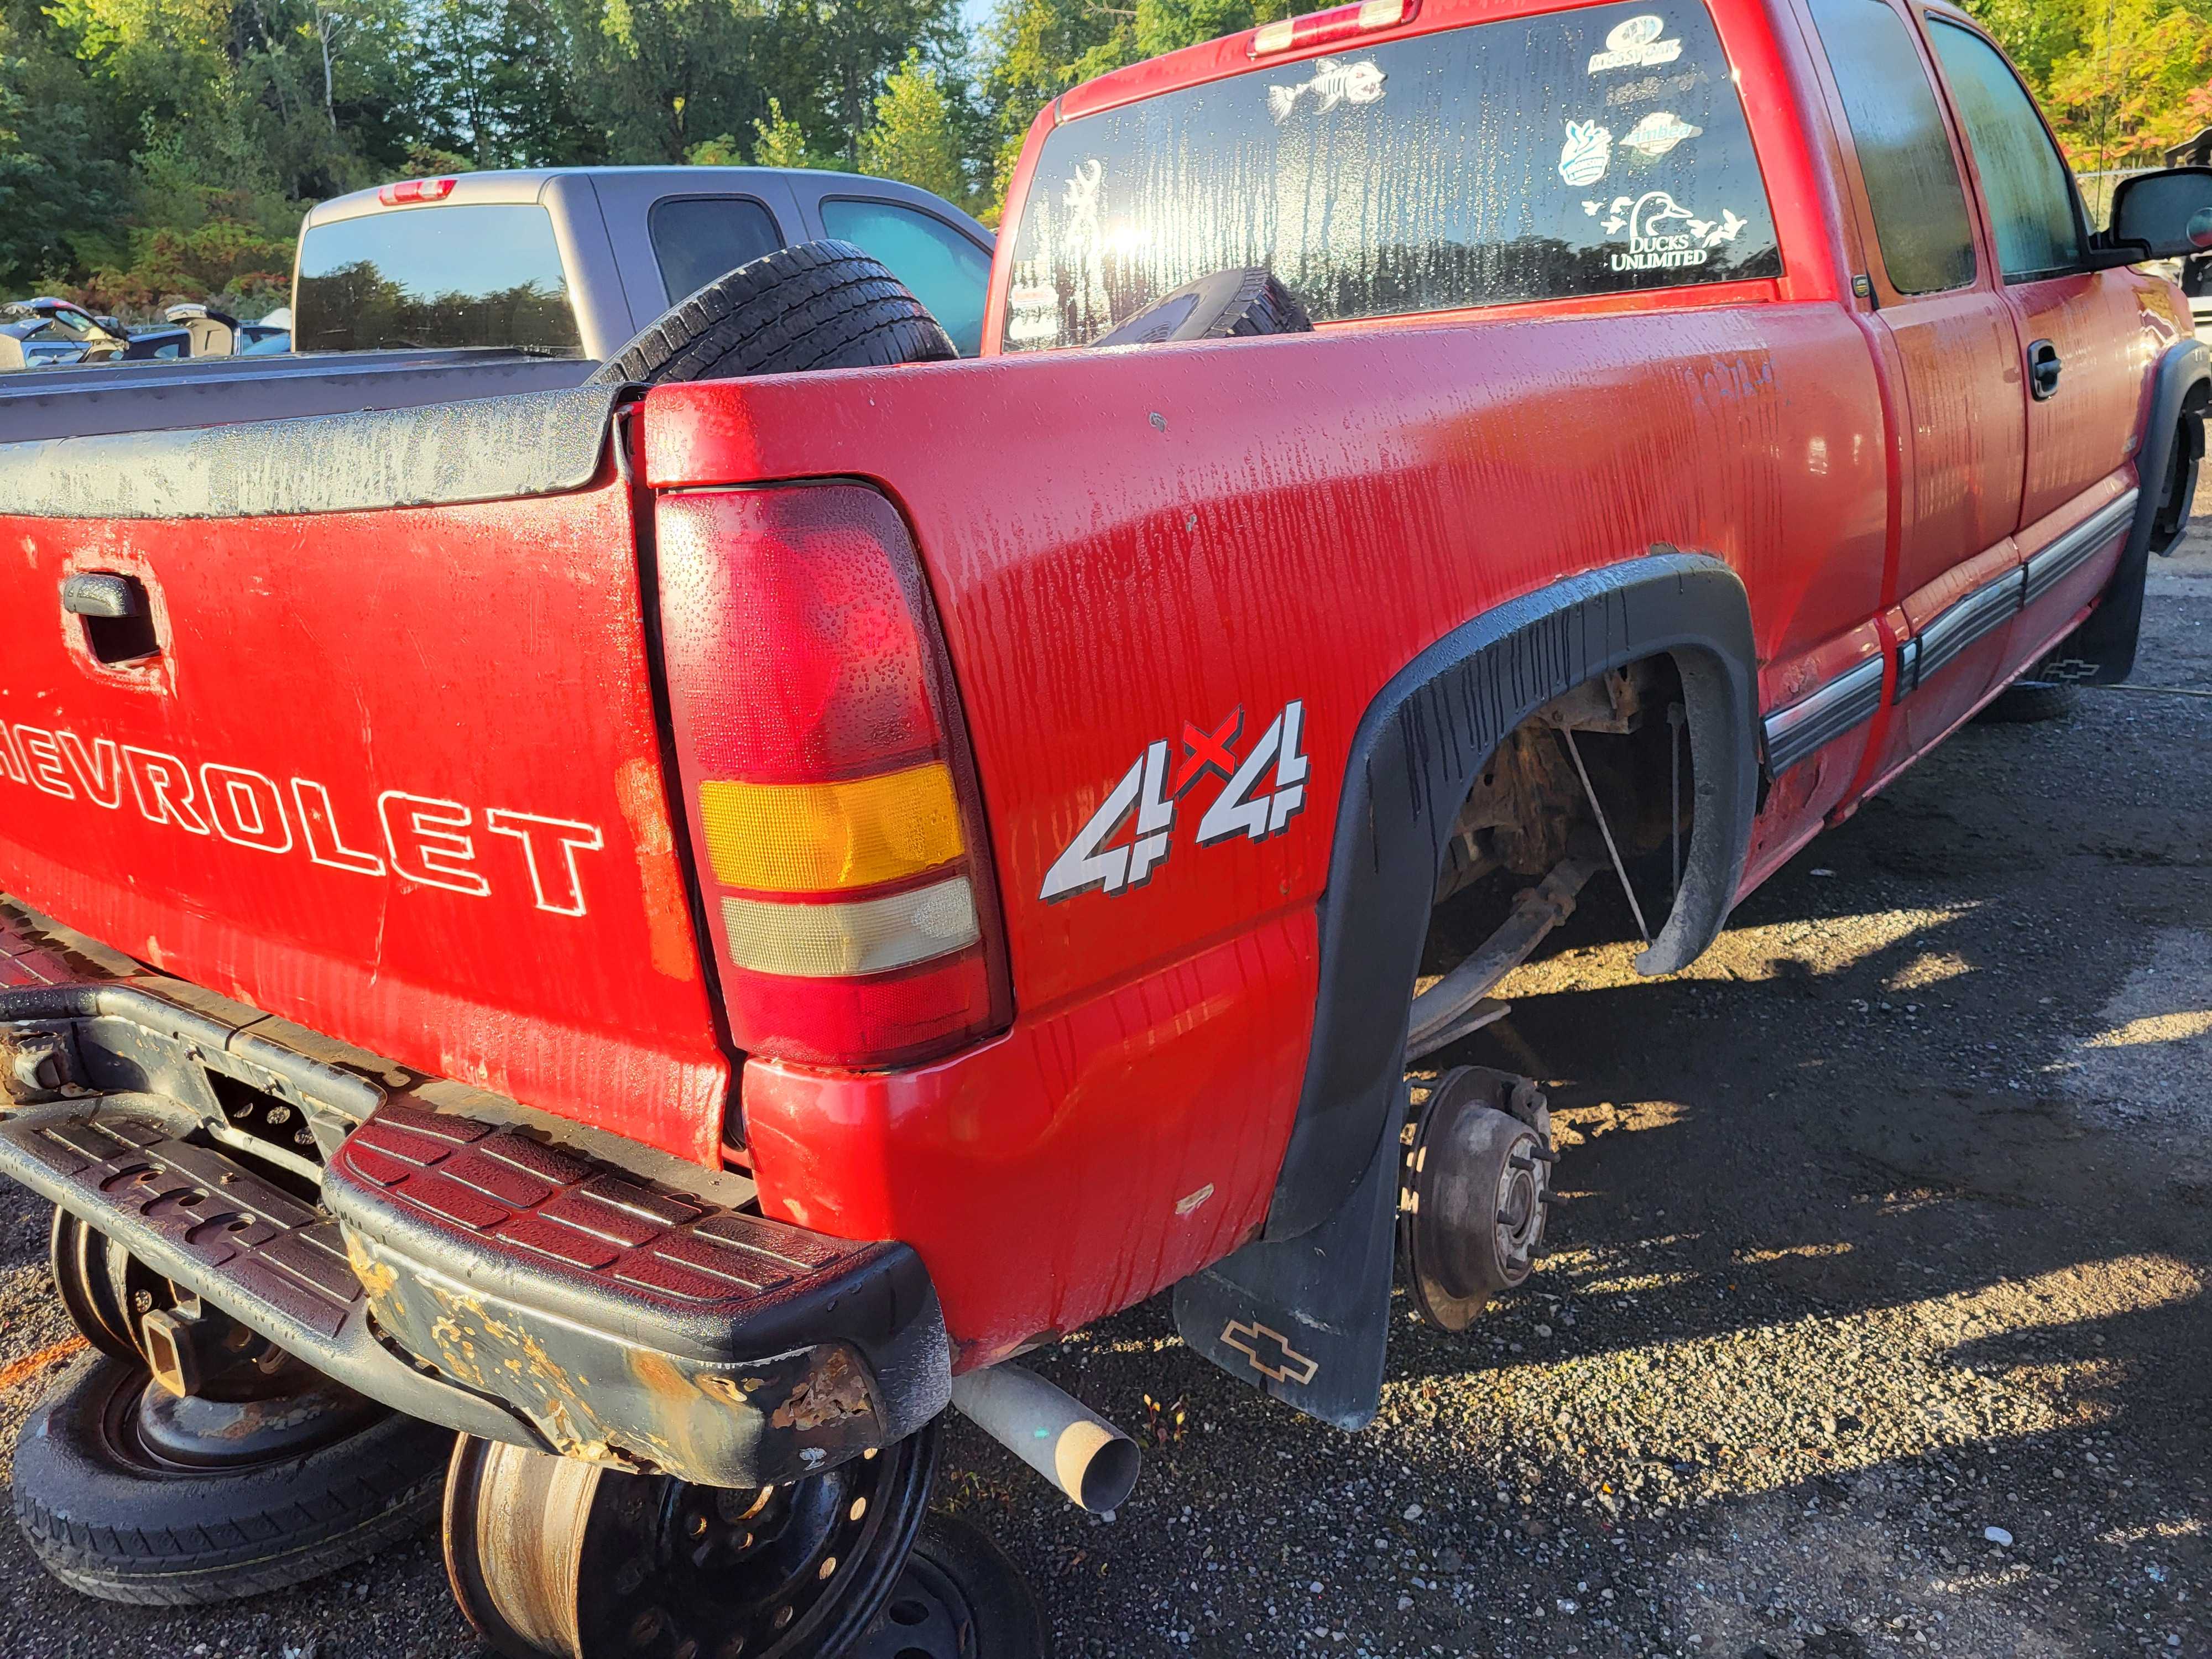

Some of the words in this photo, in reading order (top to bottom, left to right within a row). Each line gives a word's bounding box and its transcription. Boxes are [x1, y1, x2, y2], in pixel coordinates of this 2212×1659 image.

[1590, 48, 1642, 68] MOSSY
[1629, 234, 1689, 254] DUCKS
[1611, 249, 1708, 272] UNLIMITED
